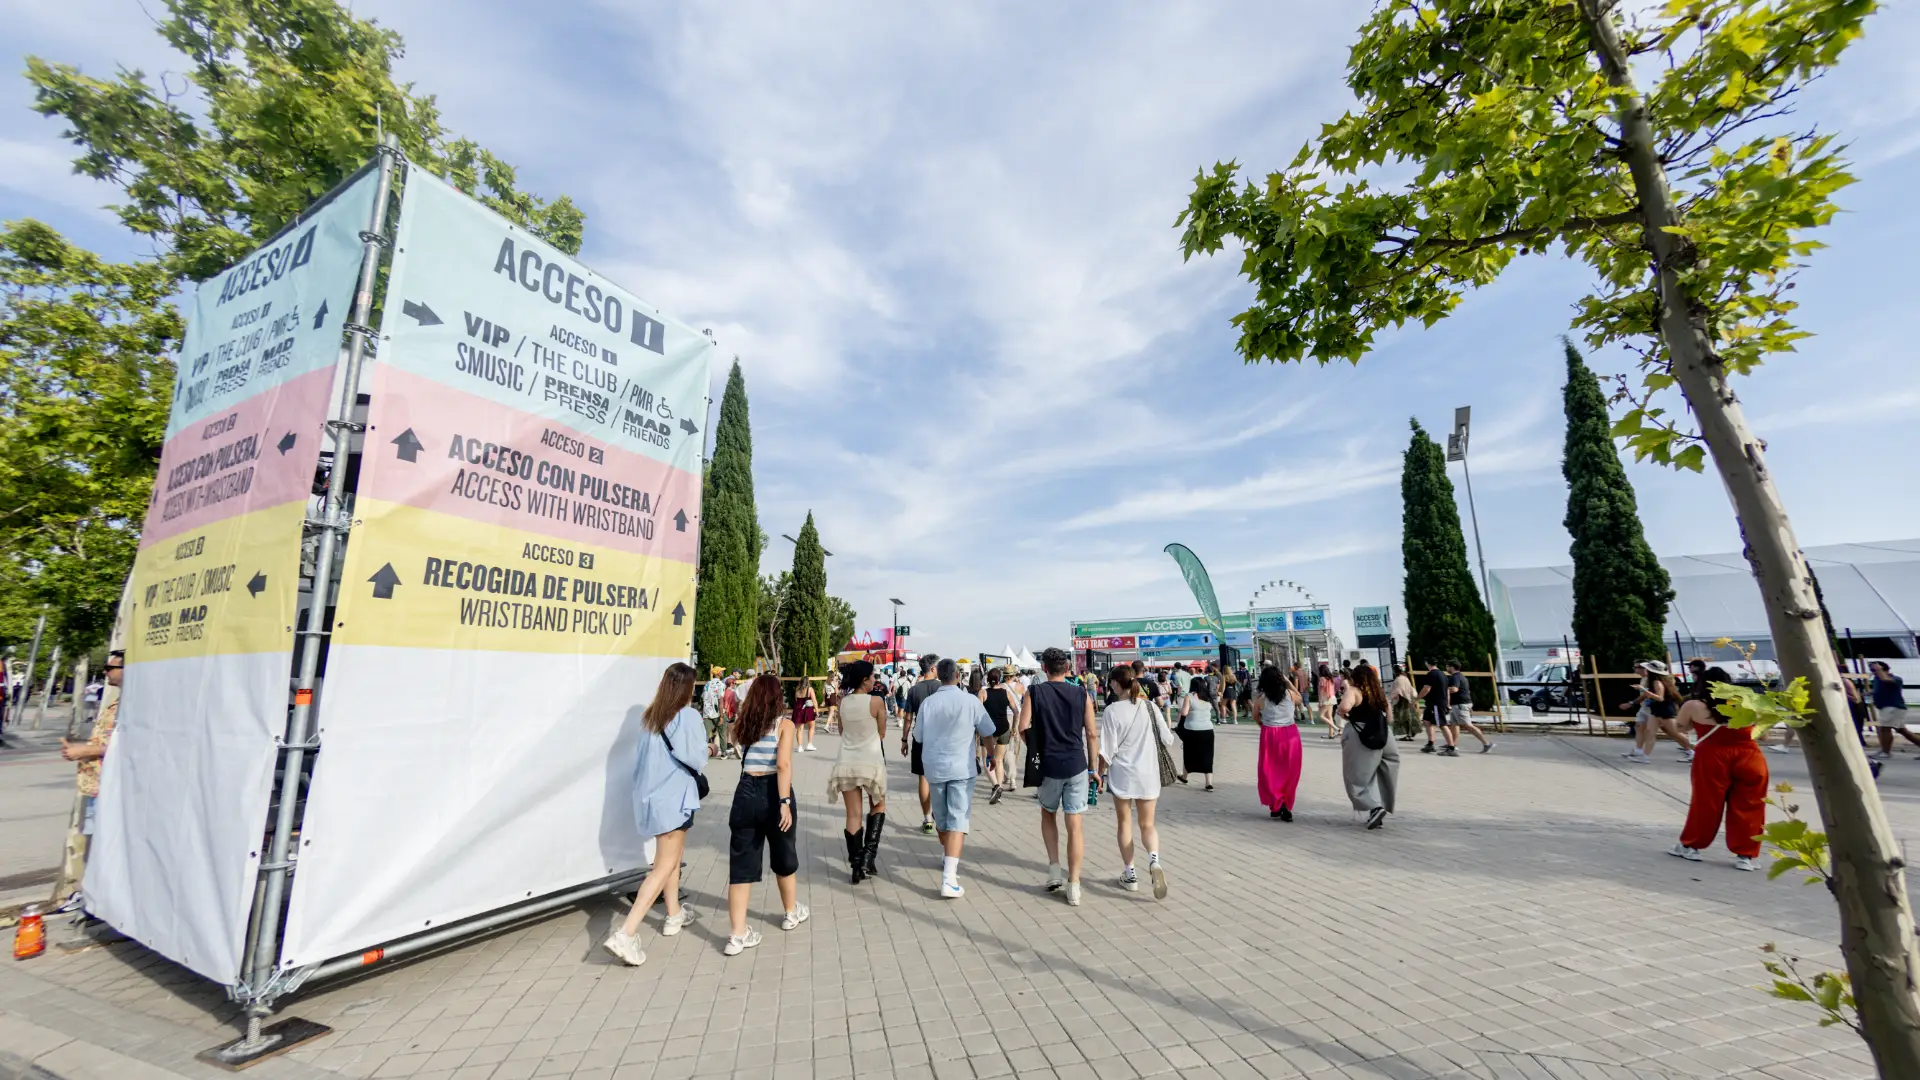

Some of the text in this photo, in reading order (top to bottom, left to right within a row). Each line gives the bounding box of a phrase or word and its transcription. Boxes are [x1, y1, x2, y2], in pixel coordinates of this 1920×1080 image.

[217, 242, 293, 307] ACCESO
[494, 237, 622, 333] ACCESO
[216, 339, 238, 367] THE
[261, 337, 295, 363] MAD
[550, 324, 597, 358] ACCESO
[464, 311, 510, 348] VIP
[532, 342, 567, 375] THE
[573, 359, 617, 393] CLUB
[630, 384, 653, 413] PMR
[212, 373, 249, 398] PRESS
[456, 342, 524, 392] SMUSIC
[545, 375, 610, 411] PRENSA
[624, 409, 671, 437] MAD
[544, 389, 670, 450] PRESS FRIENDS
[540, 428, 584, 458] ACCESO
[448, 434, 532, 481] ACCESO
[537, 461, 575, 493] CON
[451, 469, 654, 541] ACCESS WITH WRISTBAND
[522, 543, 574, 566] ACCESO
[423, 557, 537, 598] RECOGIDA
[542, 577, 567, 601] DE
[179, 605, 208, 624] MAD
[460, 597, 633, 636] WRISTBAND PICK UP
[1144, 620, 1193, 631] ACCESO
[1075, 639, 1109, 649] FAST TRACK
[1203, 636, 1209, 644] 1
